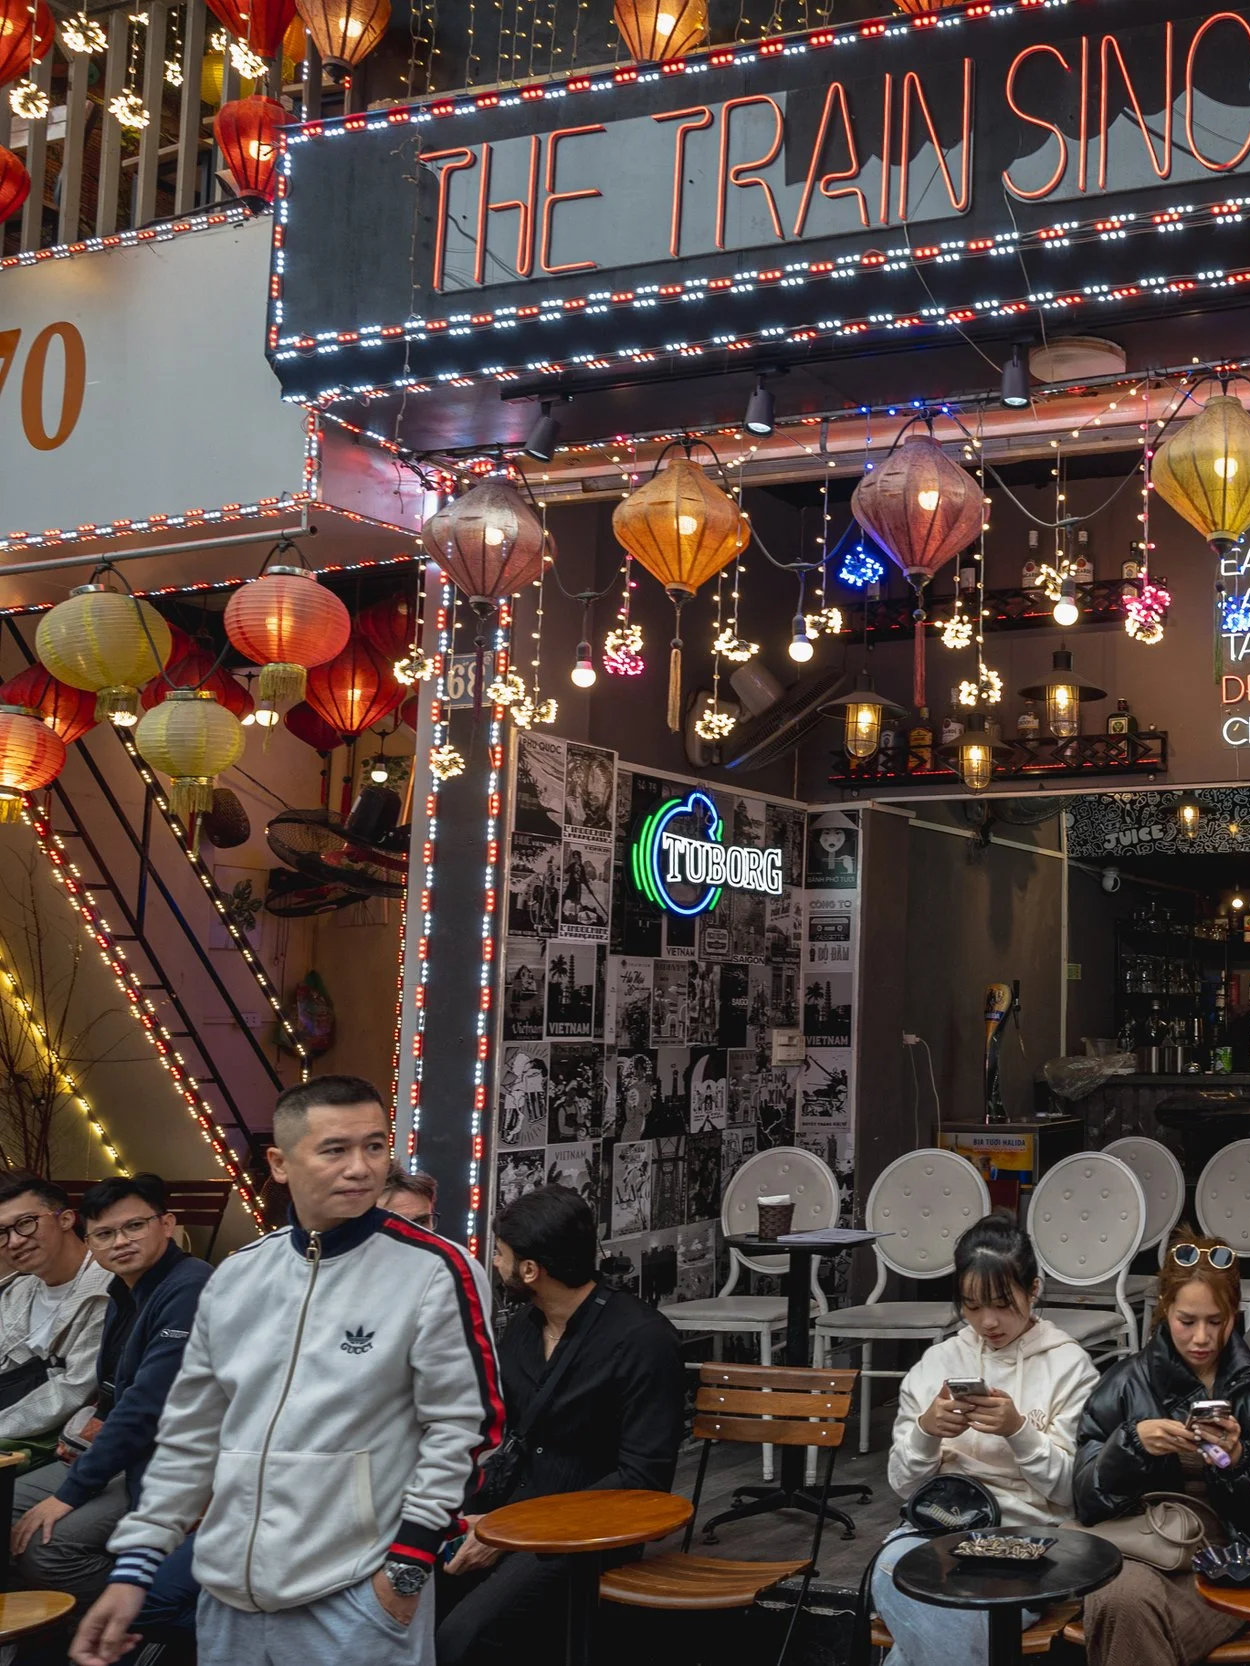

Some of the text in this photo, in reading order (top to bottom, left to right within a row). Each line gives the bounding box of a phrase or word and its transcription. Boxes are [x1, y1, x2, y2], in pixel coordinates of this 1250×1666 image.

[419, 123, 607, 292] THE
[651, 56, 971, 258] TRAIN
[1103, 824, 1164, 849] JUICE
[661, 831, 783, 895] TUBORG
[733, 955, 765, 964] SAIGON
[548, 1022, 590, 1034] VIETNAM
[805, 1035, 849, 1046] VIETNAM
[554, 1150, 587, 1161] VIETNAM
[340, 1341, 373, 1355] GUCCI
